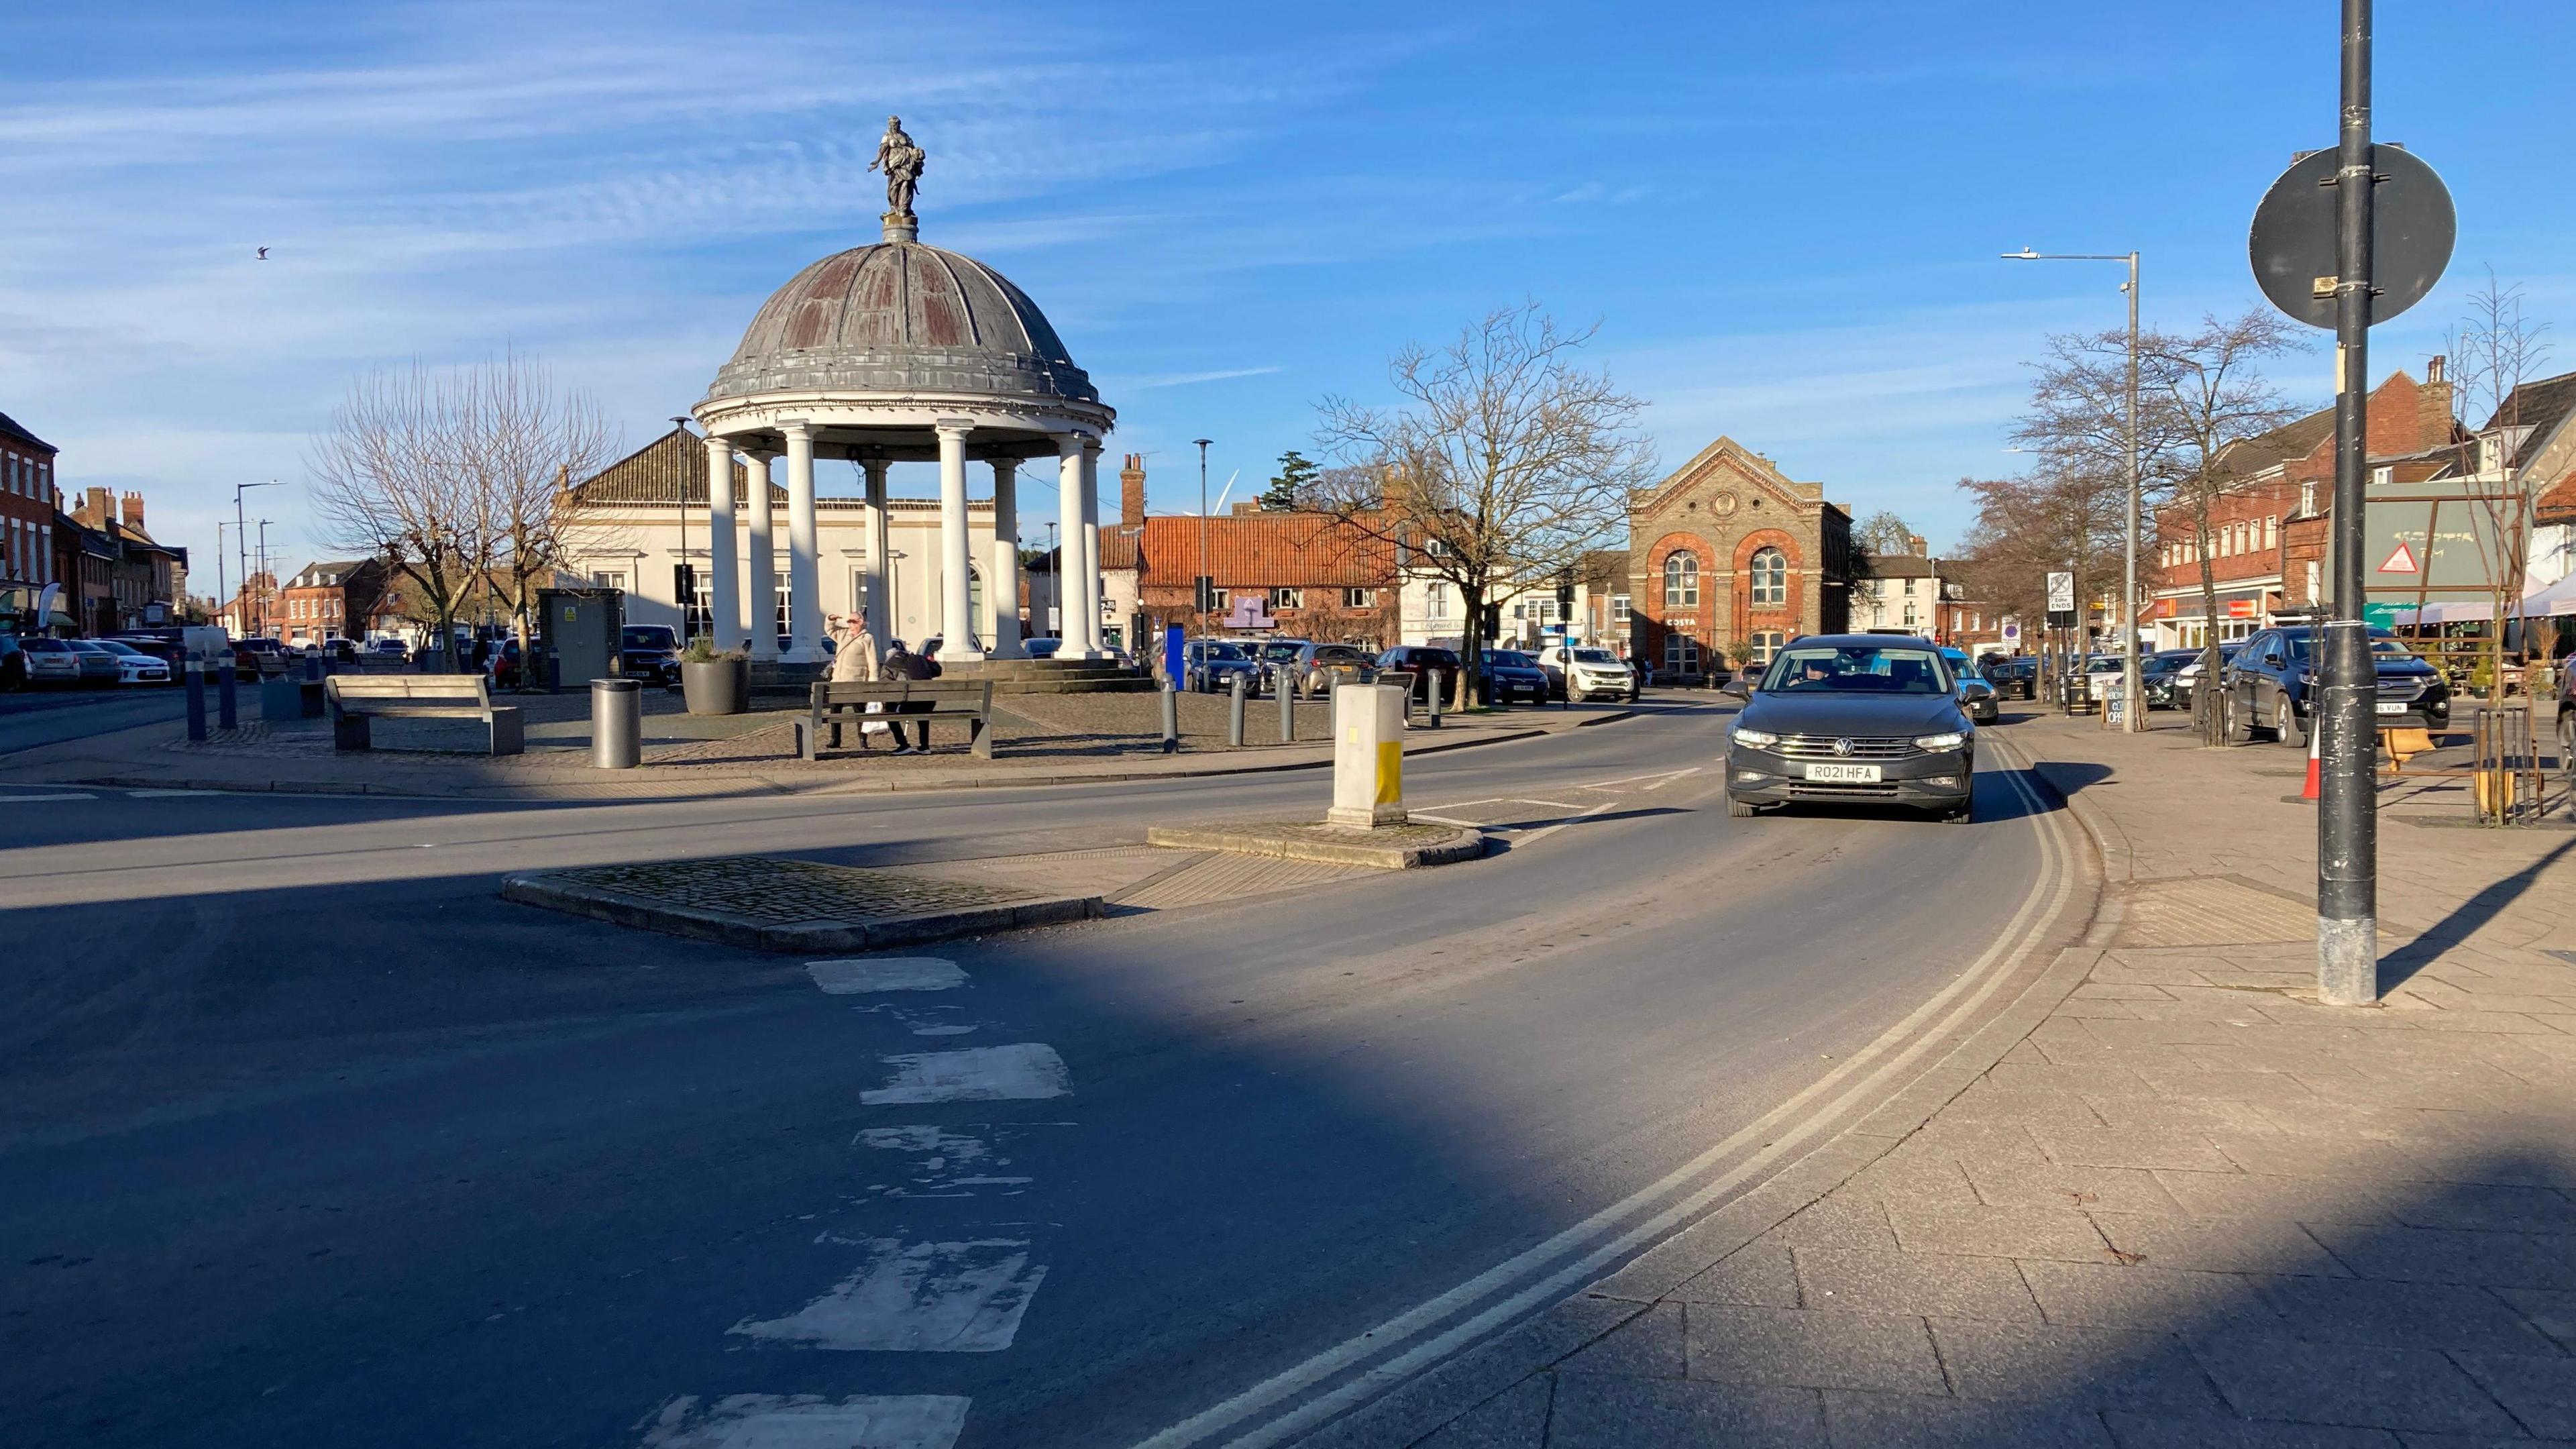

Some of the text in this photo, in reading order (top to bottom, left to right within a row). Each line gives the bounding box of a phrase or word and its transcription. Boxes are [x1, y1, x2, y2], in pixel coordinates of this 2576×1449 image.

[1667, 619, 1696, 627] COSTA
[1815, 767, 1871, 779] RO21 HFA
